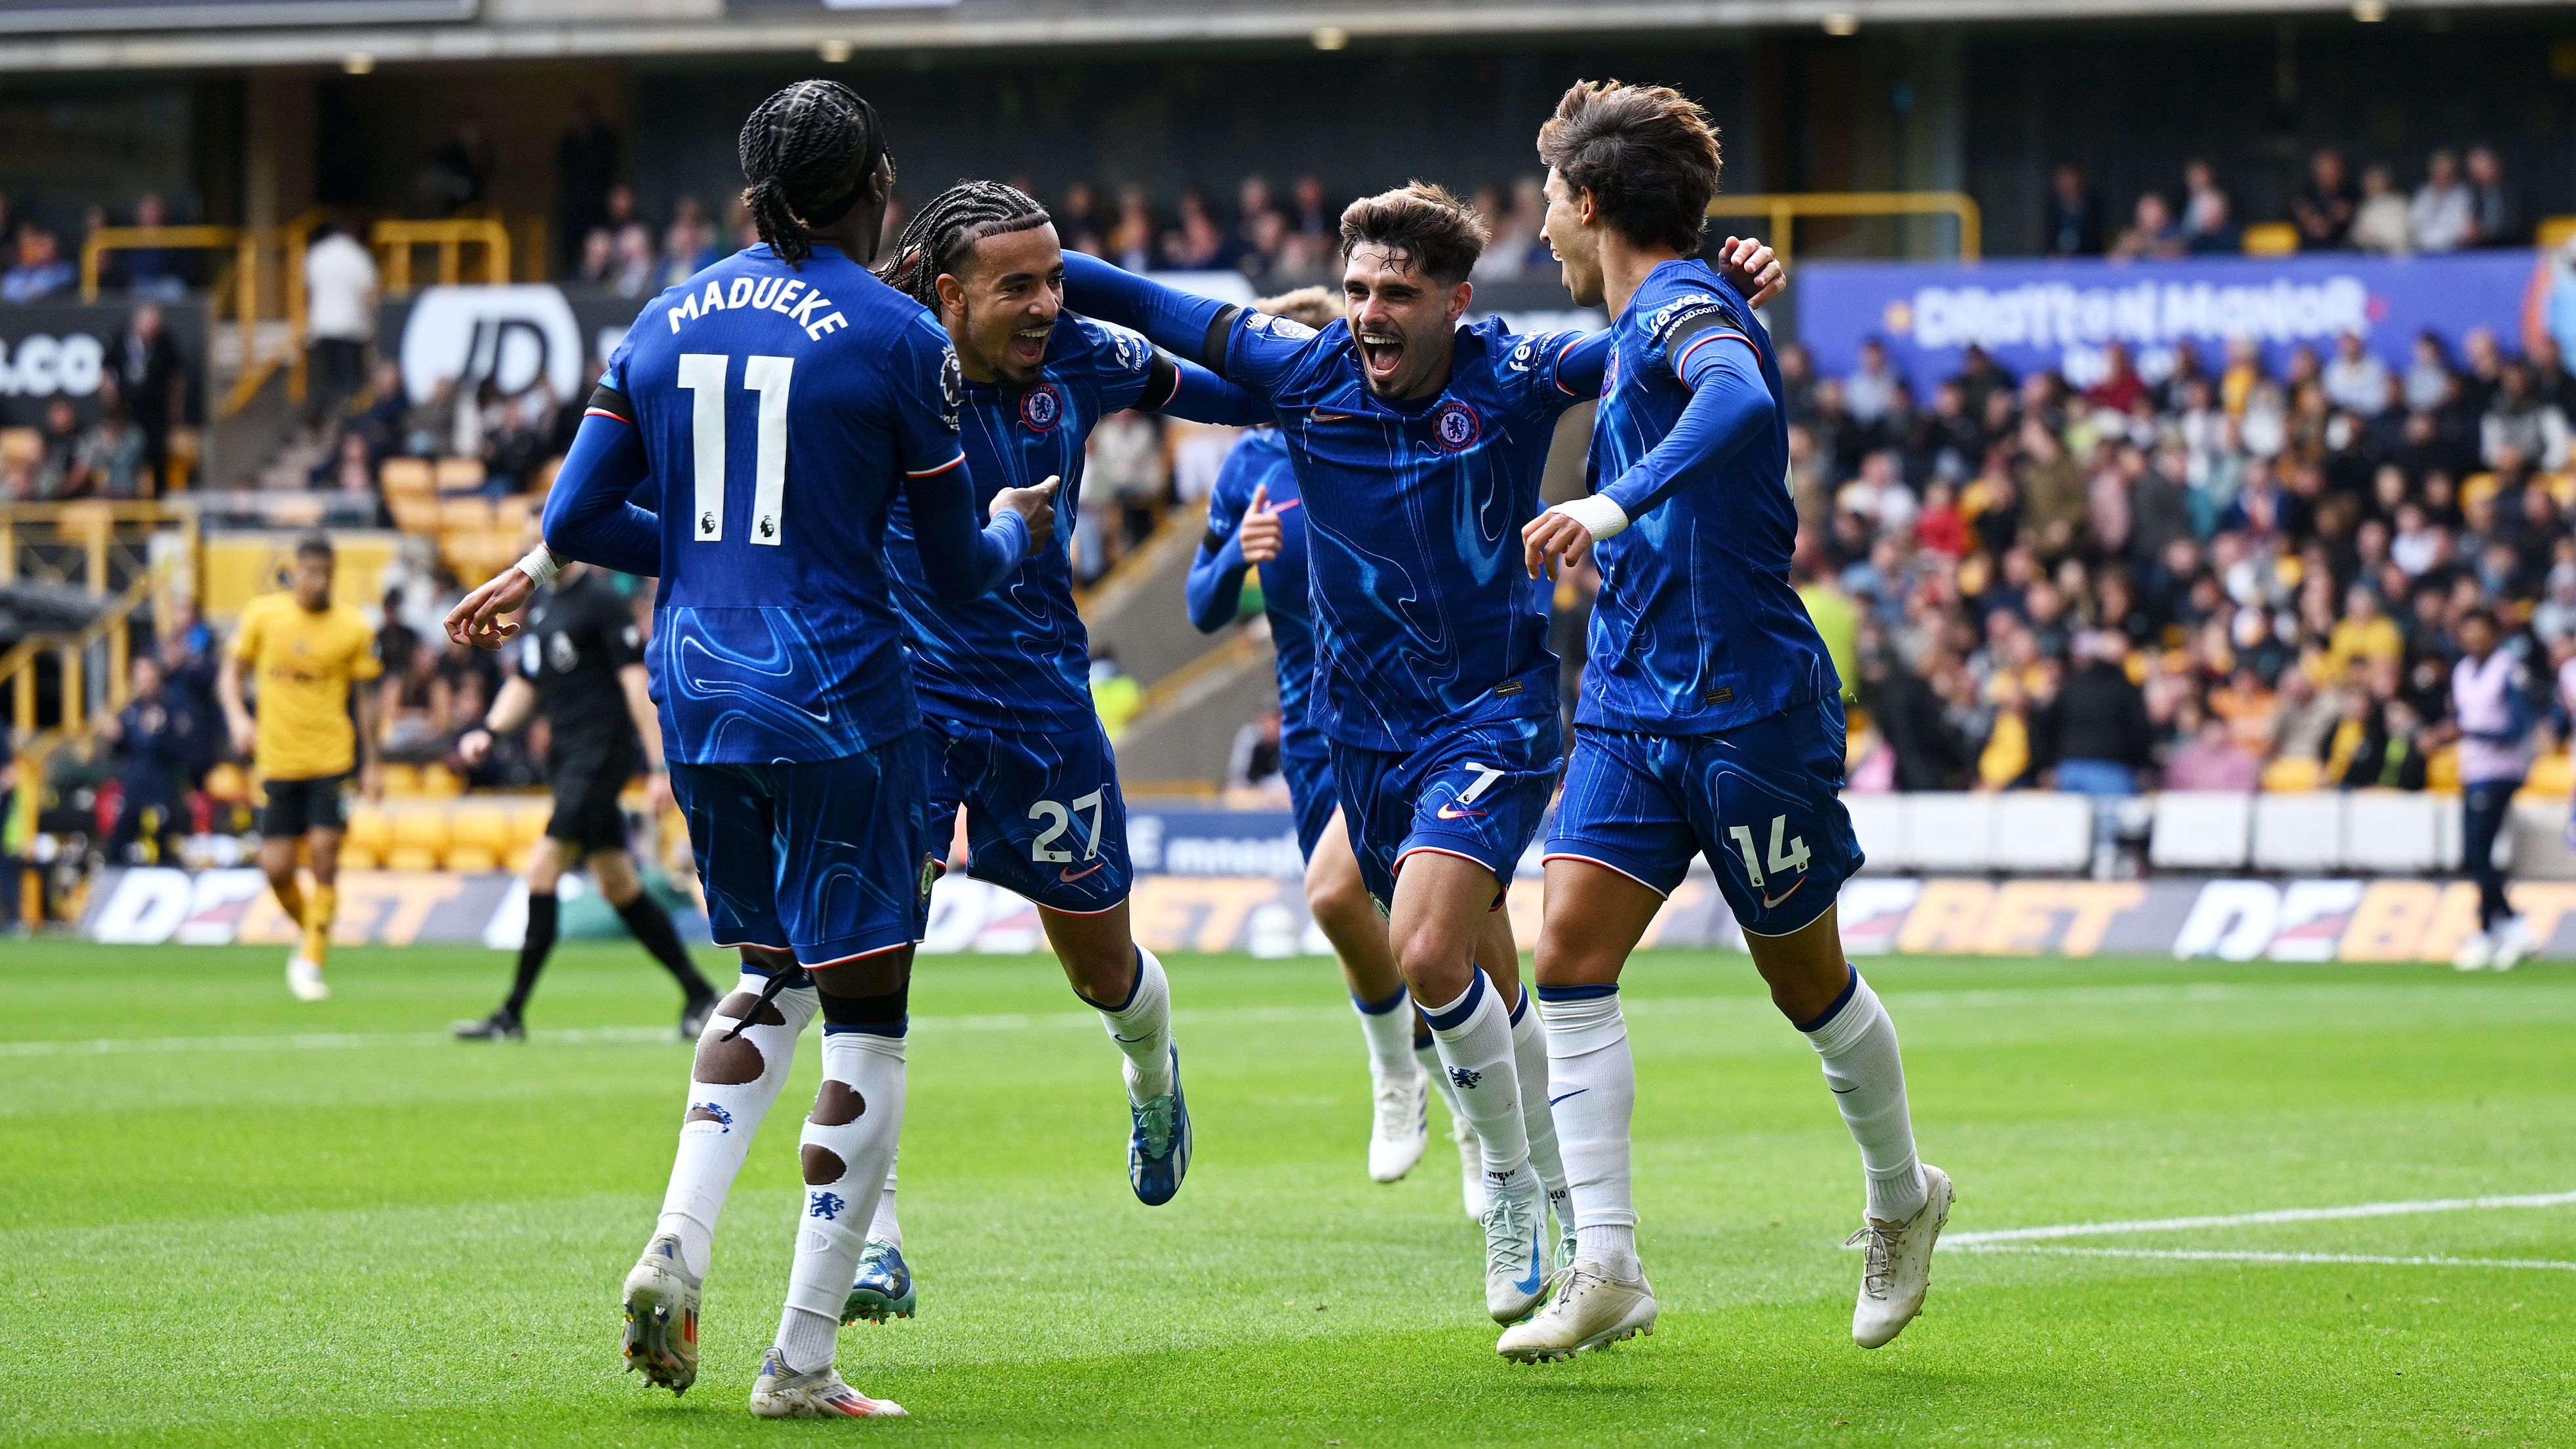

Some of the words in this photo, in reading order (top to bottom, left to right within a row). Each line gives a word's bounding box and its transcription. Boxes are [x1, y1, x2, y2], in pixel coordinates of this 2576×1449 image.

[668, 277, 848, 342] MADUEKE
[1650, 294, 1710, 336] fever
[1109, 330, 1130, 369] fev
[1509, 332, 1537, 372] fev
[1440, 406, 1467, 416] CHELSEA
[677, 354, 795, 546] 11
[1456, 762, 1505, 805] 7
[1028, 787, 1102, 863] 27
[1729, 814, 1812, 887] 14
[1549, 1189, 1566, 1201] eto
